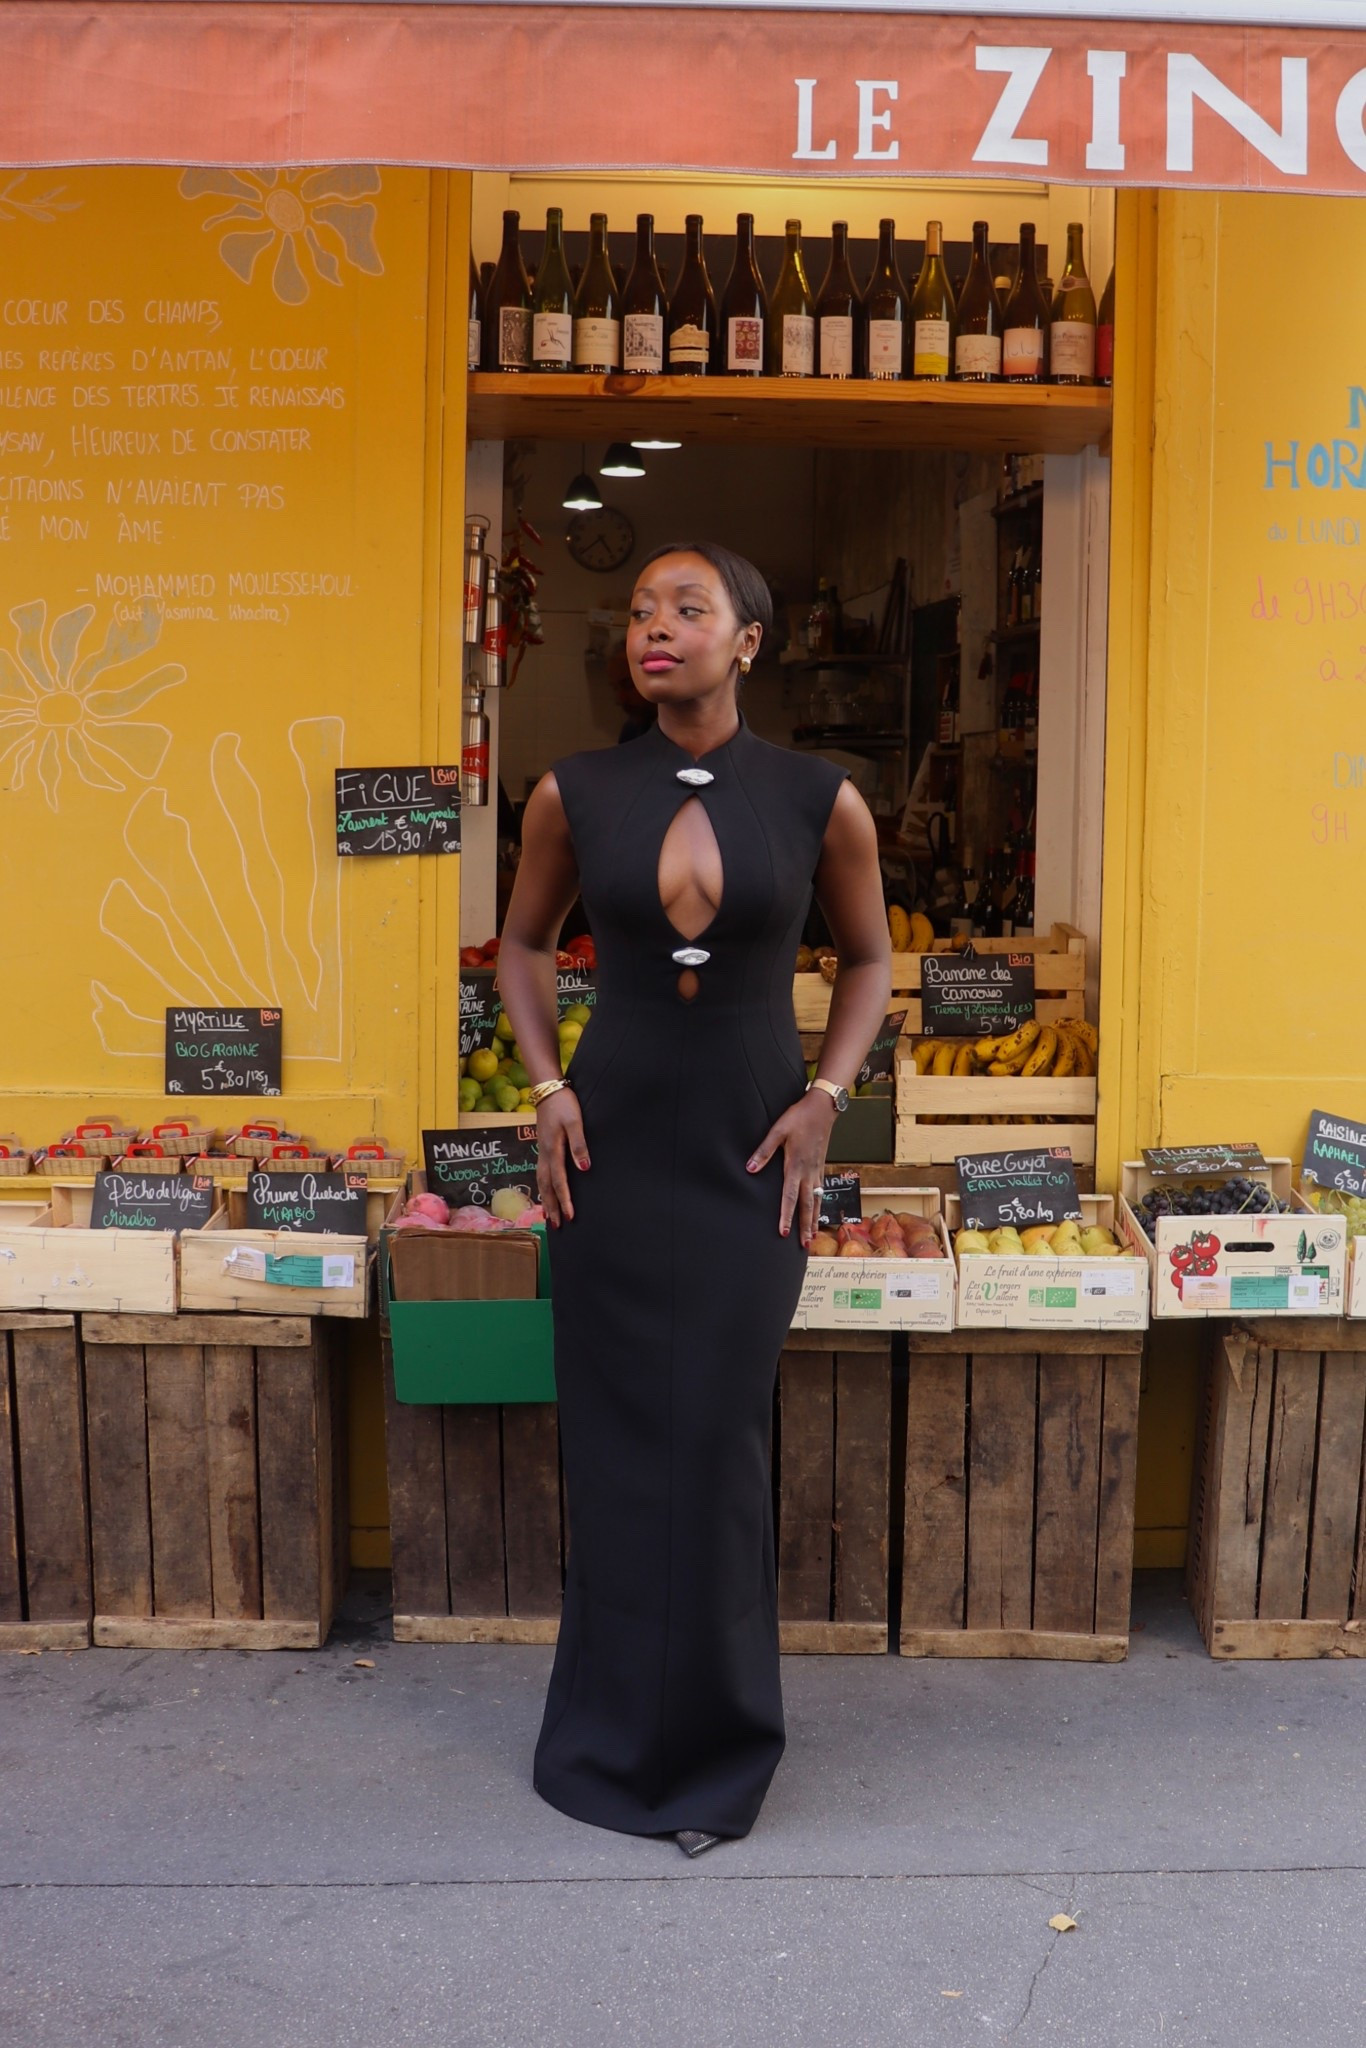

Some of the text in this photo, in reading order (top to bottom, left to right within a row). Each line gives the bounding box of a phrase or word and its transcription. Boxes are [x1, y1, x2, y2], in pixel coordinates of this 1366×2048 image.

[792, 78, 899, 160] LE
[4, 299, 223, 337] COEUR DES CHAMPS,
[39, 344, 116, 372] REPÈRES
[73, 386, 112, 408] DES
[214, 386, 239, 409] JE
[72, 423, 161, 457] HEUREUX
[172, 429, 197, 455] DE
[210, 428, 311, 453] CONSTATER
[238, 484, 285, 510] PAS
[40, 514, 89, 541] MON
[1267, 516, 1361, 547] du LUNDI
[96, 573, 215, 597] MOHAMMED
[1251, 575, 1282, 621] de
[156, 602, 219, 622] Yasmina
[338, 842, 354, 854] FR
[924, 957, 988, 983] Banane
[990, 961, 1013, 981] des
[168, 1080, 184, 1093] FR
[433, 1140, 502, 1159] MANGUE
[104, 1174, 155, 1207] Pêche
[156, 1181, 169, 1200] de
[252, 1173, 299, 1205] Prune
[967, 1179, 1007, 1192] EARL
[984, 1265, 997, 1277] Le
[997, 1264, 1019, 1280] fruit
